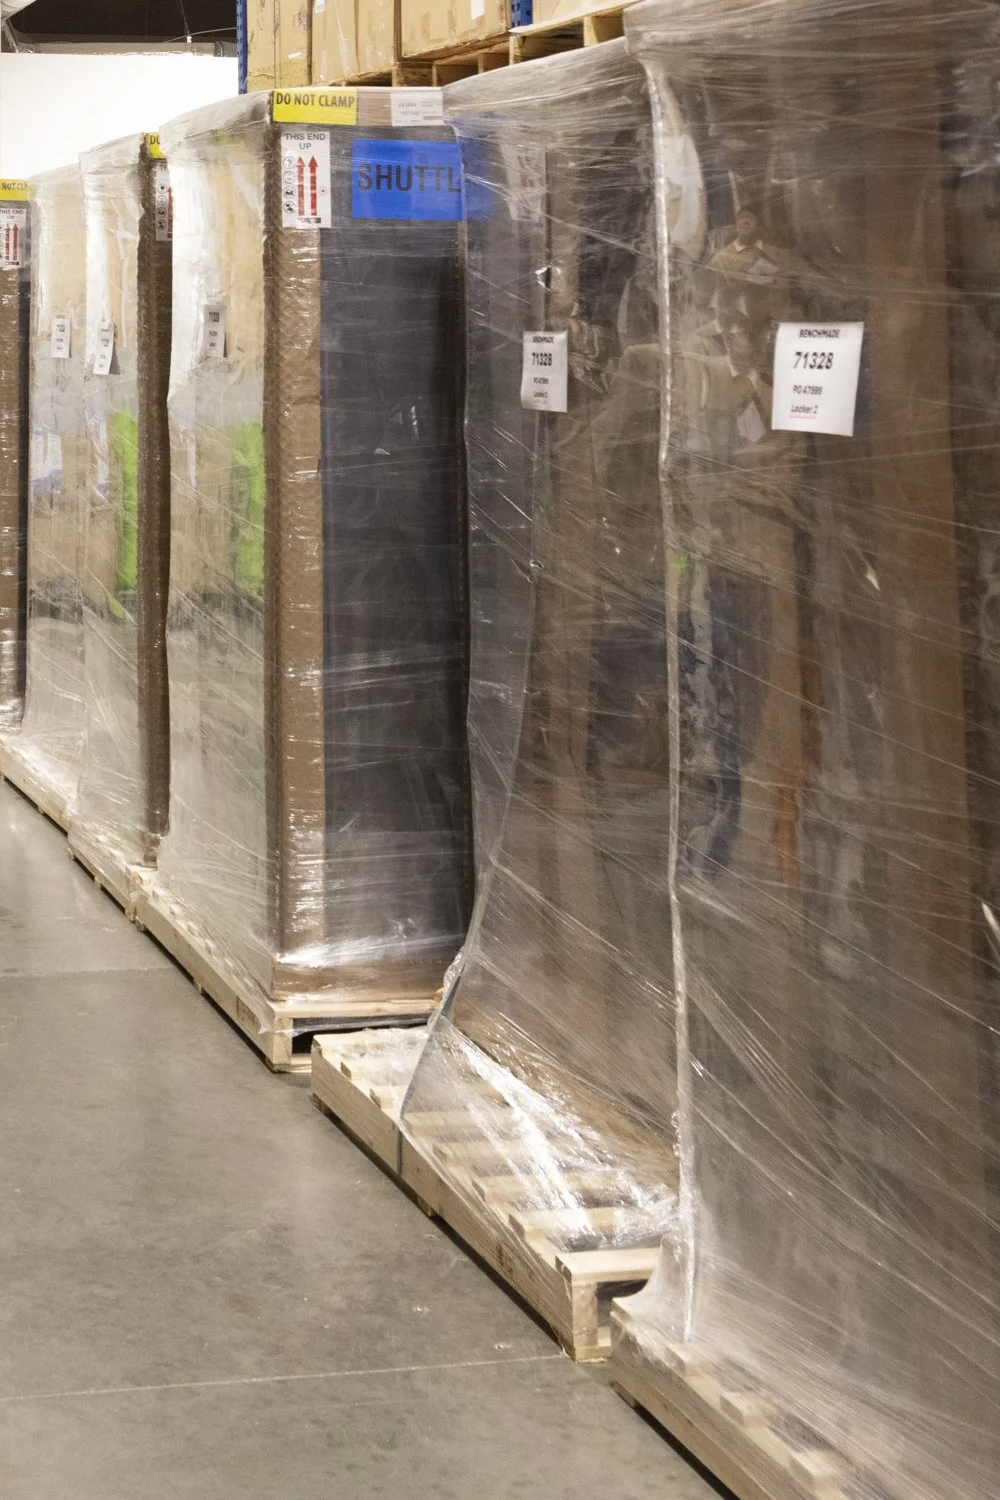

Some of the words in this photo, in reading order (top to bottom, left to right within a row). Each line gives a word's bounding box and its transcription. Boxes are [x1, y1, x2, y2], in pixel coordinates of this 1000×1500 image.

[276, 92, 291, 105] DO
[294, 93, 316, 106] NOT
[318, 94, 355, 109] CLAMP
[285, 133, 306, 141] THIS
[307, 133, 326, 141] END
[299, 142, 312, 150] UP
[357, 163, 462, 193] SHUTTL
[2, 182, 15, 190] NOT
[799, 329, 841, 339] BENCHMADE
[532, 352, 553, 367] 71328
[793, 351, 835, 370] 71328
[792, 384, 802, 394] PO
[813, 404, 819, 414] 2
